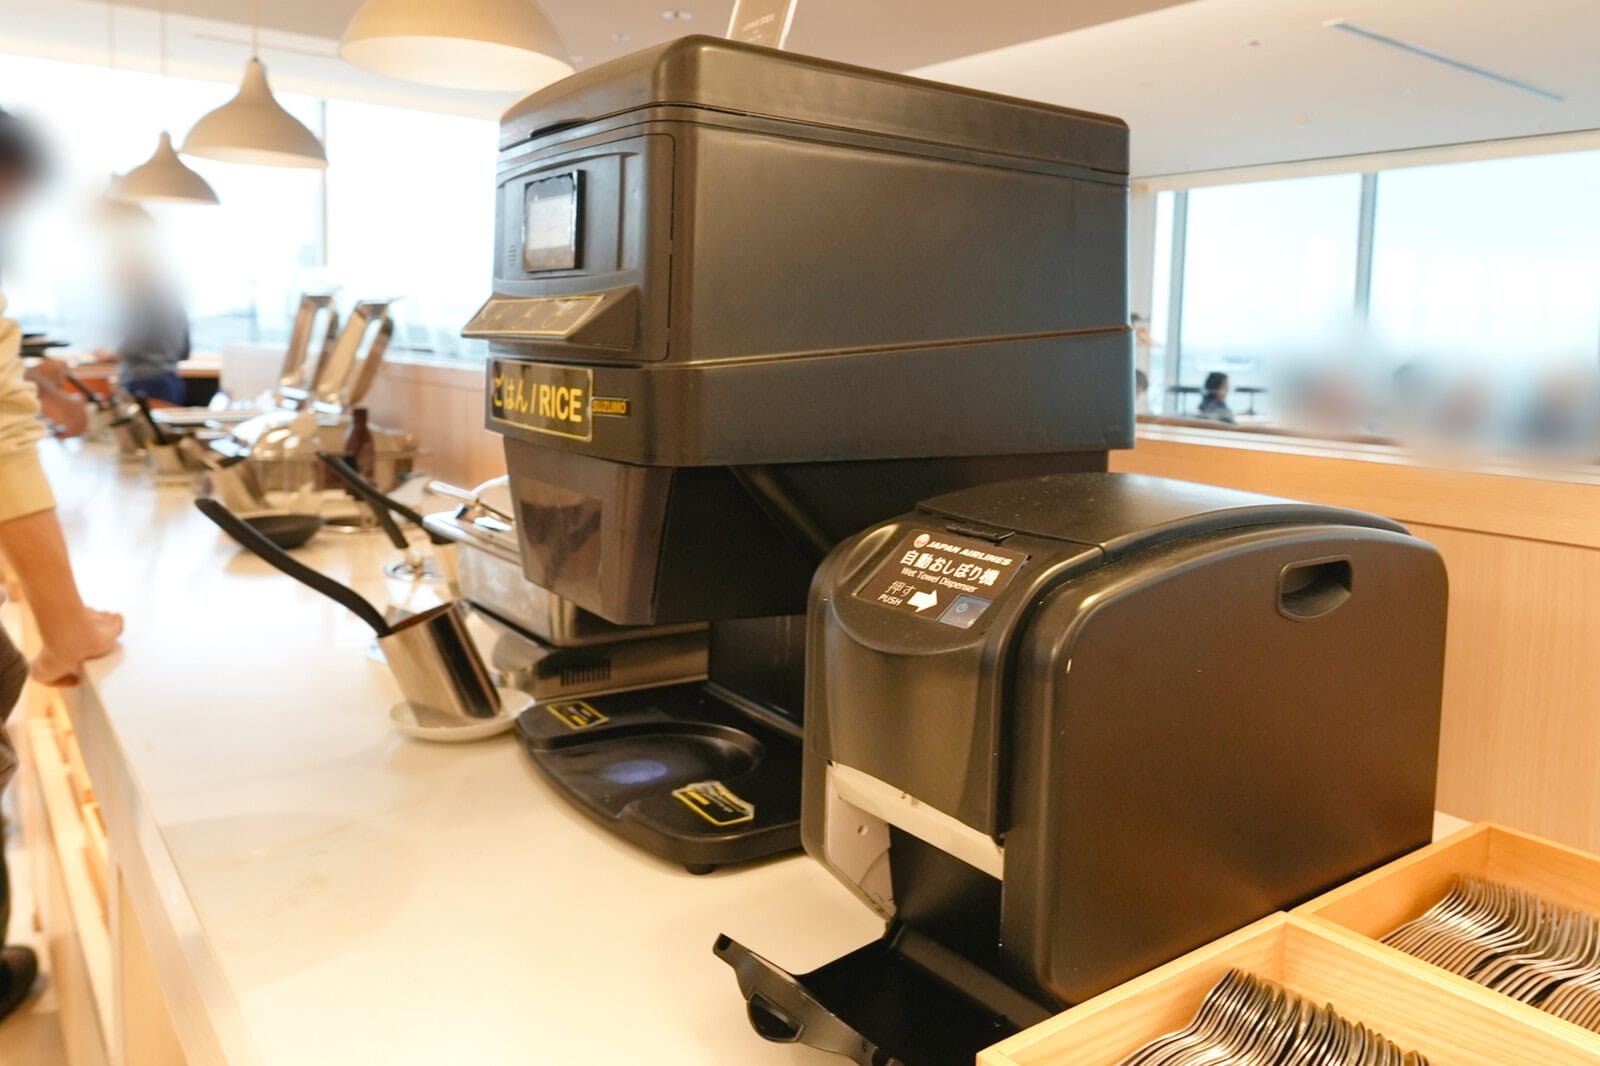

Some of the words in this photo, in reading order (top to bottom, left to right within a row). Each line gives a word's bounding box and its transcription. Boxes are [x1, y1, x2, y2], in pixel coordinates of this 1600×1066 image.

[539, 384, 582, 423] RICE
[592, 400, 627, 414] SUZUMO
[926, 541, 962, 554] JAPAN
[959, 548, 1013, 566] AIRLINES
[900, 549, 1000, 587] 自動おしぼり機
[901, 567, 918, 578] Wet
[917, 571, 942, 583] Towel
[938, 577, 979, 593] Dispenser
[877, 593, 903, 606] PUSH
[885, 580, 917, 597] 押す
